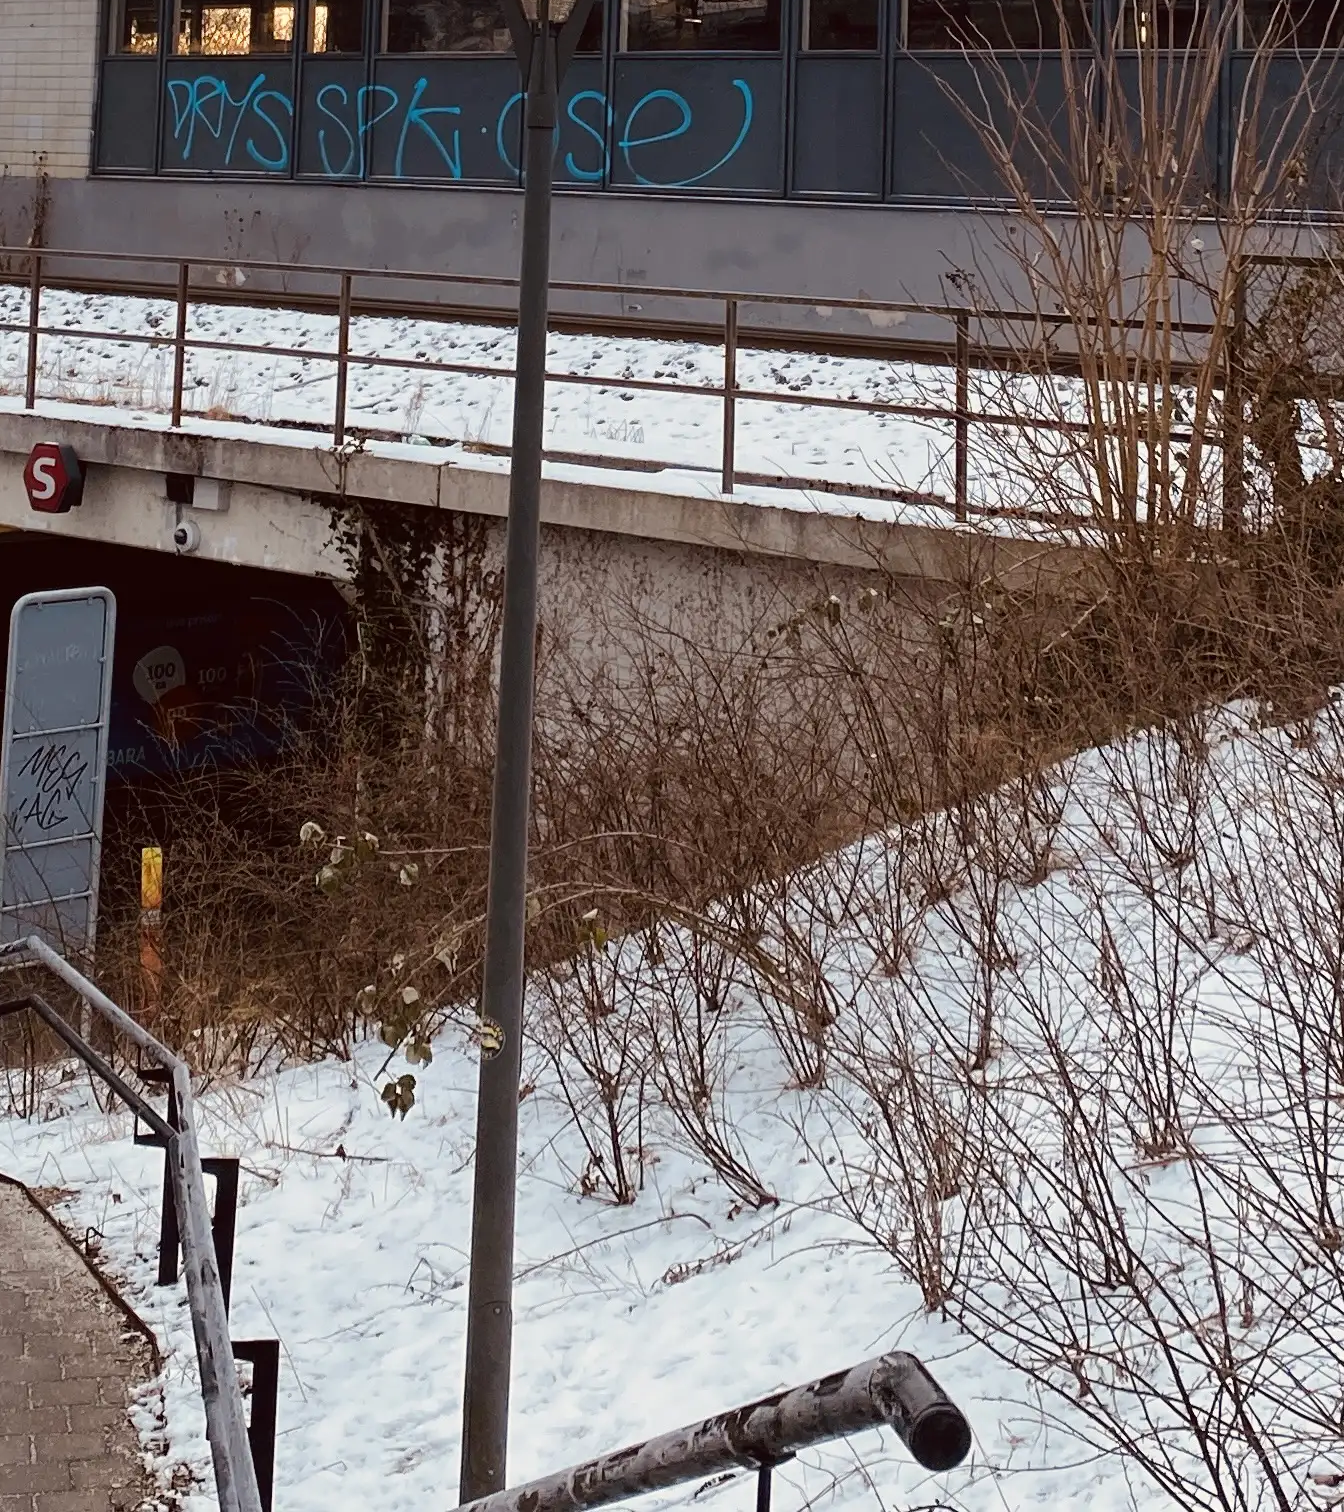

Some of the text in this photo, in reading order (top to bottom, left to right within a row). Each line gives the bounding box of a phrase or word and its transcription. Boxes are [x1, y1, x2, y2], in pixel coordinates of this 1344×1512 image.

[32, 456, 56, 500] S
[147, 662, 227, 685] 100 100
